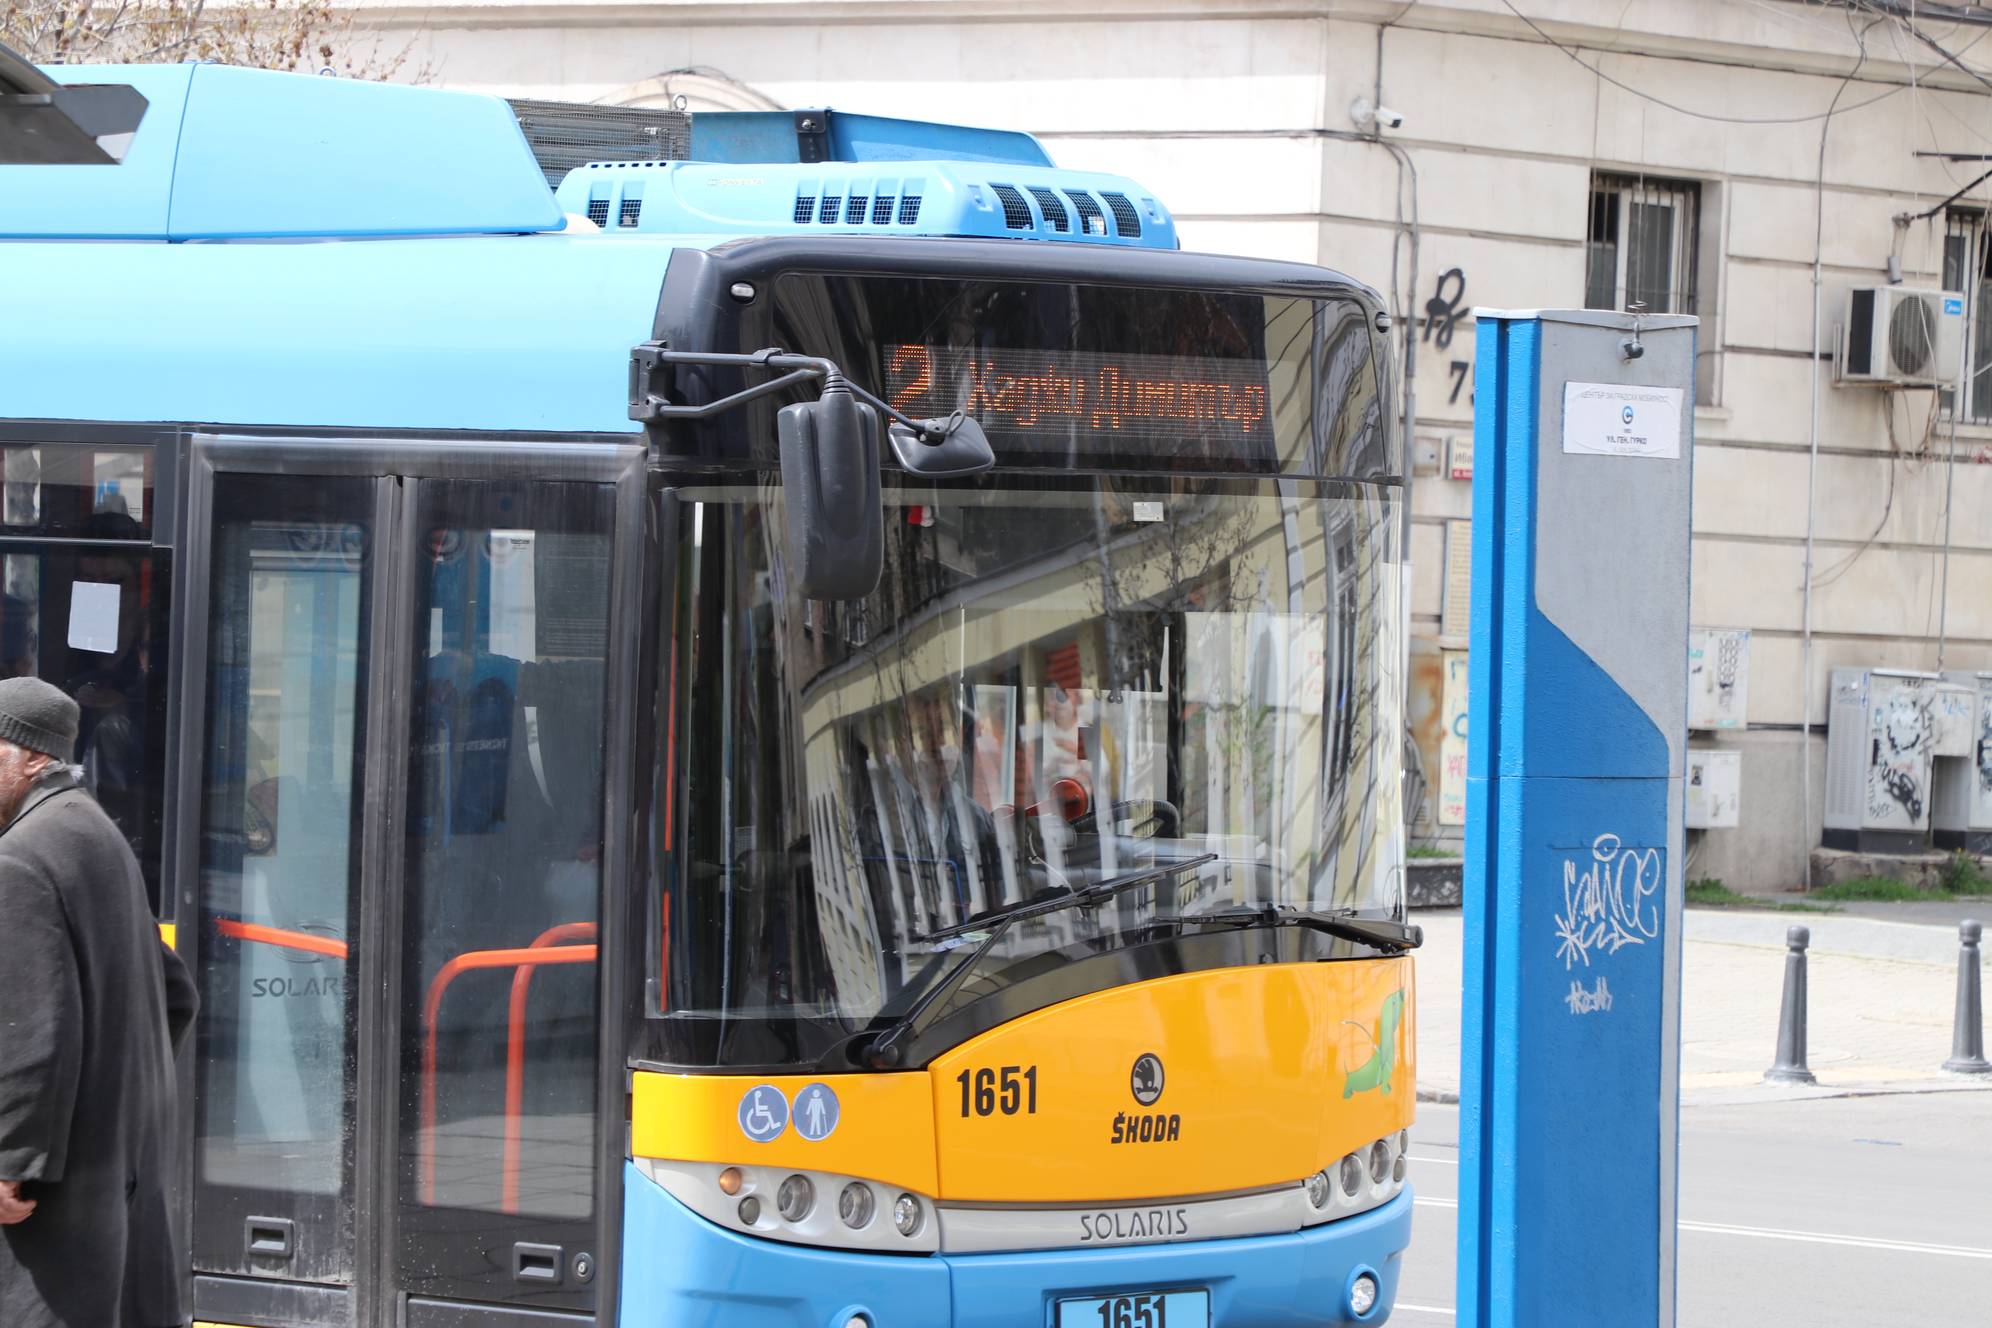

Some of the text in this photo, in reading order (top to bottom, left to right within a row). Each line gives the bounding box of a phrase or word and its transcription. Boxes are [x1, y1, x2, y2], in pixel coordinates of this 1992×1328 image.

[889, 344, 932, 426] 2
[251, 977, 340, 998] SOLAR
[957, 1065, 1037, 1118] 1651
[1111, 1111, 1181, 1144] ŠKODA
[1080, 1208, 1188, 1241] SOLARIS
[1098, 1295, 1166, 1328] 1651
